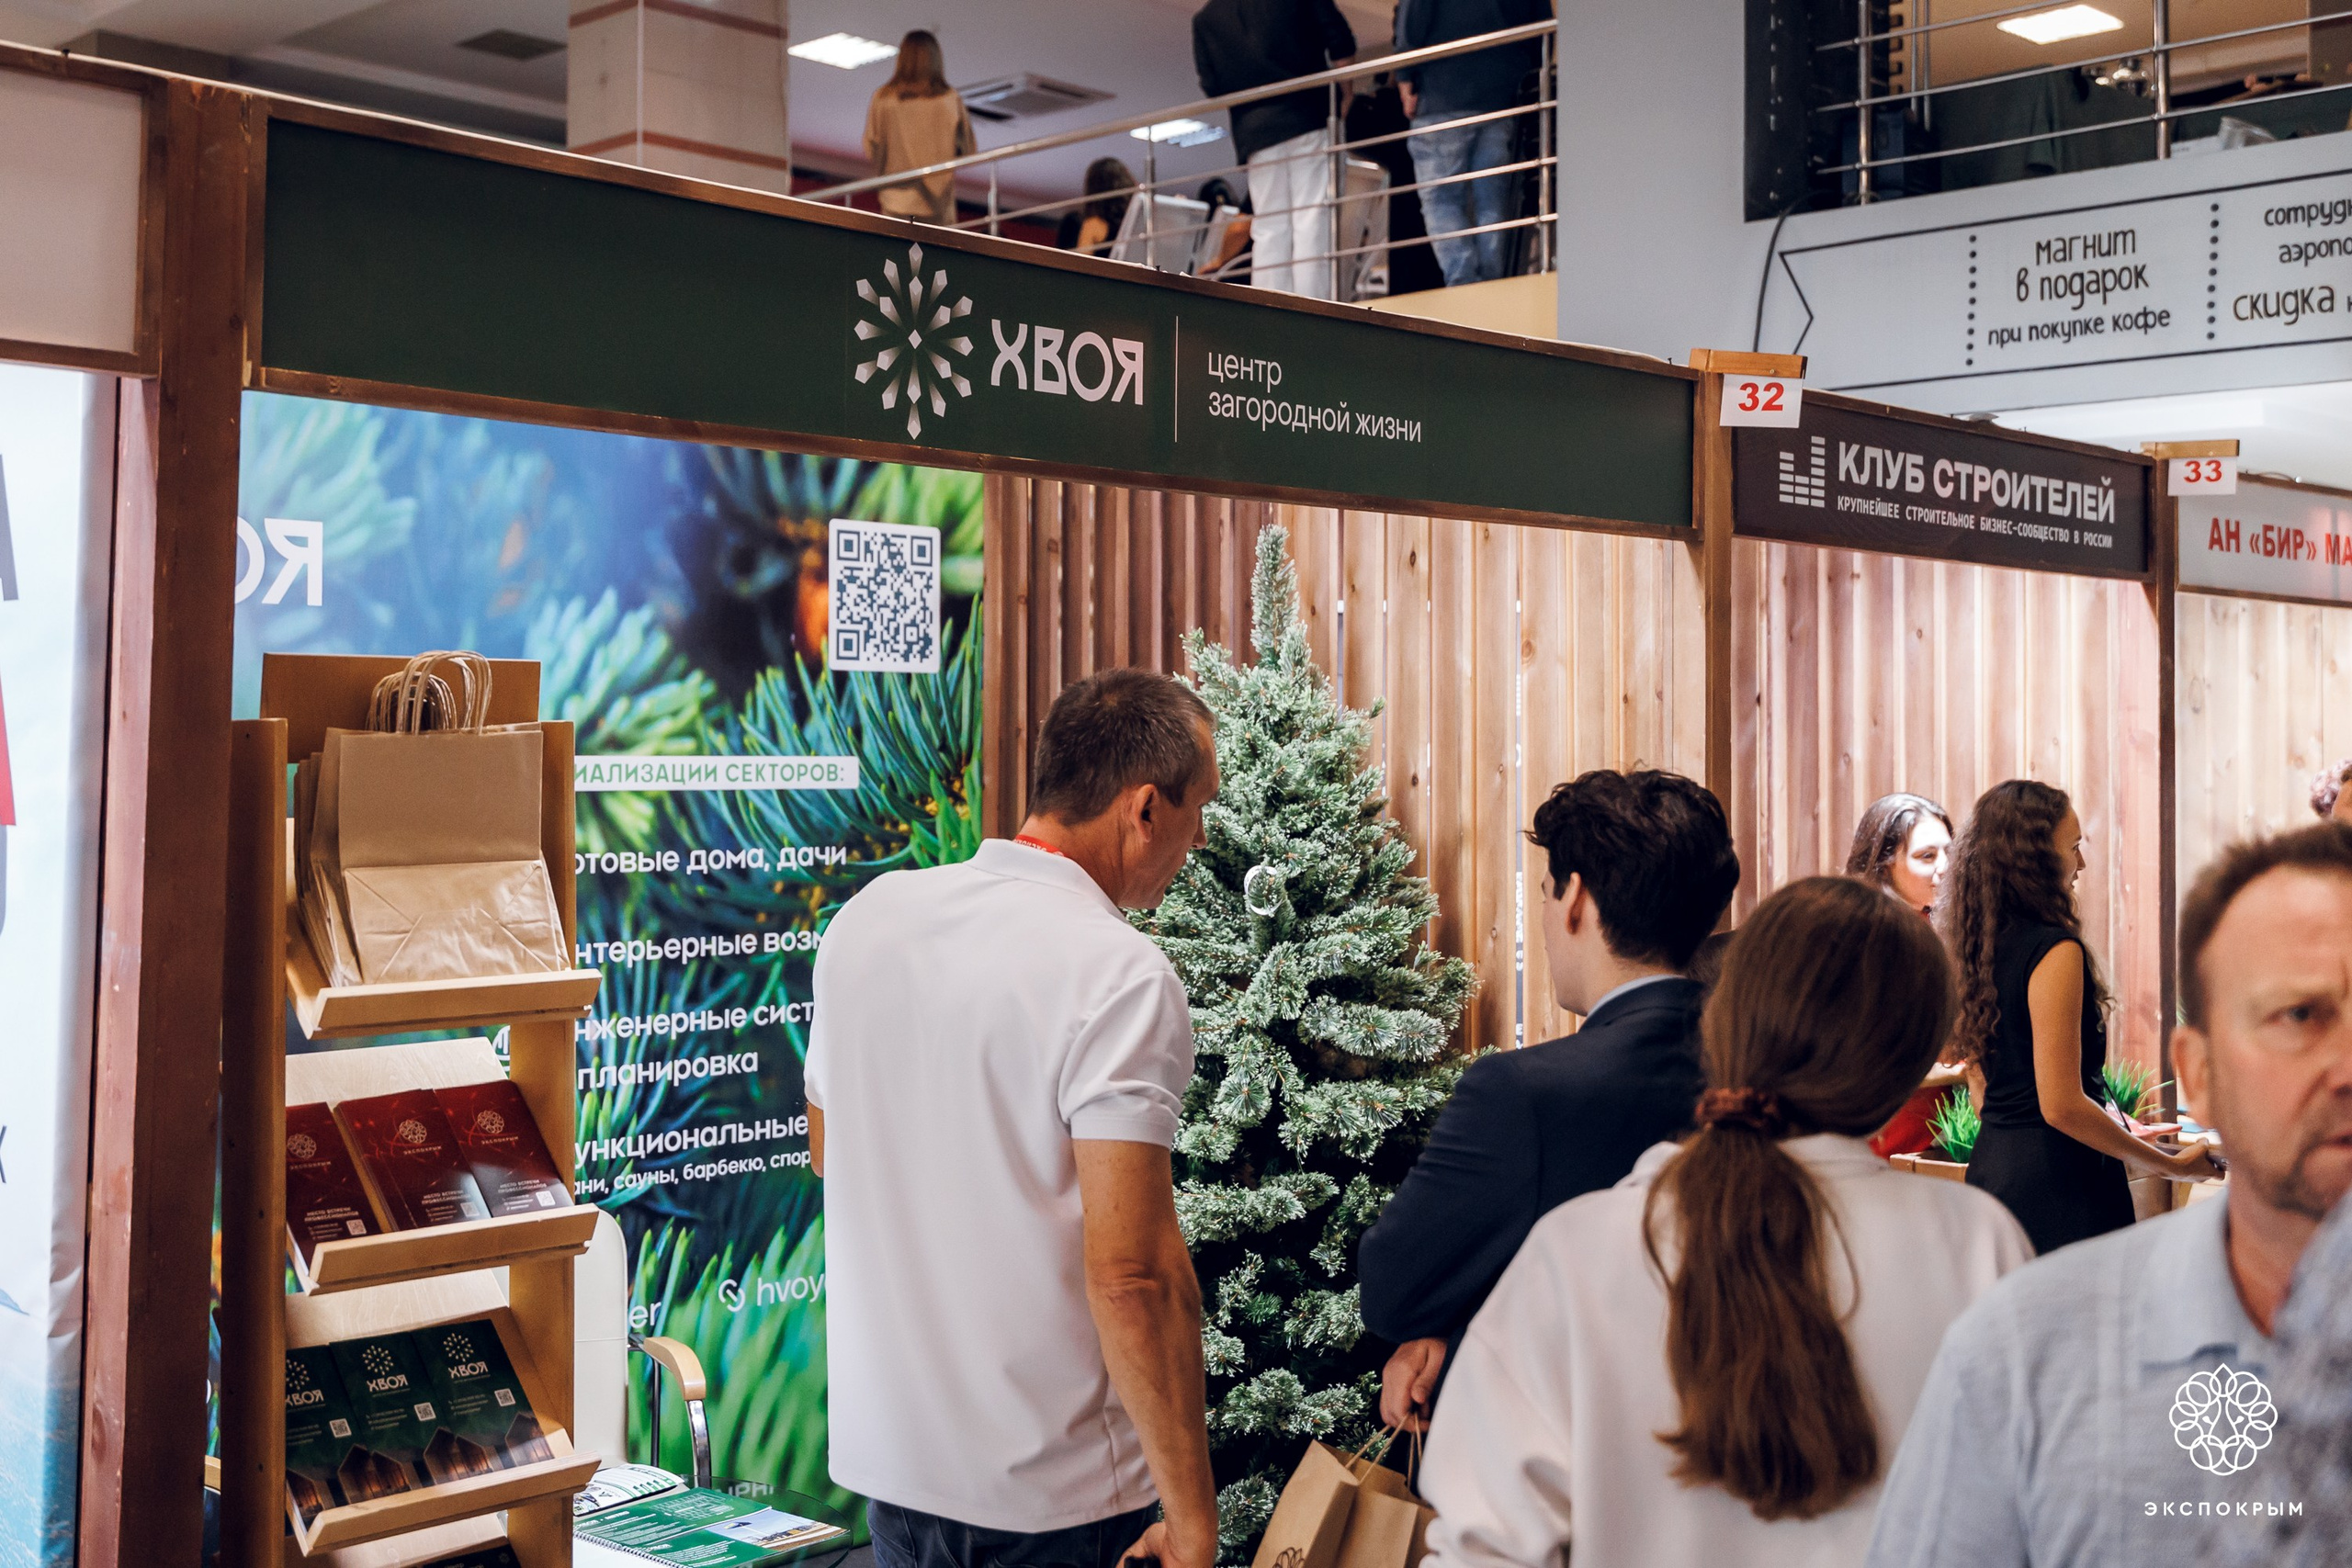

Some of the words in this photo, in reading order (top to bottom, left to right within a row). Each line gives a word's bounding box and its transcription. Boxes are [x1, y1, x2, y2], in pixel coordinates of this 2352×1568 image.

[2035, 229, 2136, 265] магнит
[2278, 236, 2352, 268] аэропо
[2016, 267, 2030, 301] в
[2040, 264, 2150, 311] подарок
[2233, 286, 2335, 326] скидка
[1988, 327, 2021, 348] при
[2029, 316, 2105, 344] покупке
[2112, 305, 2171, 335] кофе
[990, 318, 1145, 406] ХВОЯ
[1208, 352, 1283, 393] центр
[1737, 382, 1784, 412] 32
[1208, 391, 1351, 434] загородной
[1355, 412, 1422, 443] жизни
[1838, 441, 1926, 493] КЛУБ
[1933, 457, 2116, 524] СТРОИТЕЛЕЙ
[2183, 460, 2222, 483] 33
[1838, 495, 1900, 519] КРУПНЕЙШЕЕ
[1905, 507, 1975, 530] СТРОИТЕЛЬНОЕ
[1980, 517, 2069, 543] БИЗНЕС-СООБЩЕСТВО
[2074, 533, 2080, 545] В
[2084, 534, 2113, 548] РОССИИ
[2208, 517, 2241, 553] АН
[2249, 524, 2317, 561] «БИР»
[2324, 533, 2352, 566] МА
[575, 762, 718, 784] ИАЛИЗАЦИИ
[726, 763, 844, 783] СЕКТОРОВ:
[575, 851, 680, 874] отовые
[686, 847, 770, 874] дома,
[777, 845, 847, 871] дачи
[575, 933, 758, 967] нтерьерные
[575, 1008, 747, 1041] нженерные
[753, 1002, 814, 1026] сист
[578, 1052, 758, 1089] планировка
[575, 1114, 808, 1168] ункциональные
[613, 1169, 679, 1190] сауны,
[683, 1156, 766, 1181] барбекю,
[770, 1150, 810, 1168] спор
[757, 1273, 825, 1306] hvoy
[628, 1303, 662, 1328] er
[367, 1374, 409, 1393] ХВОЯ
[447, 1360, 489, 1380] ХВОЯ
